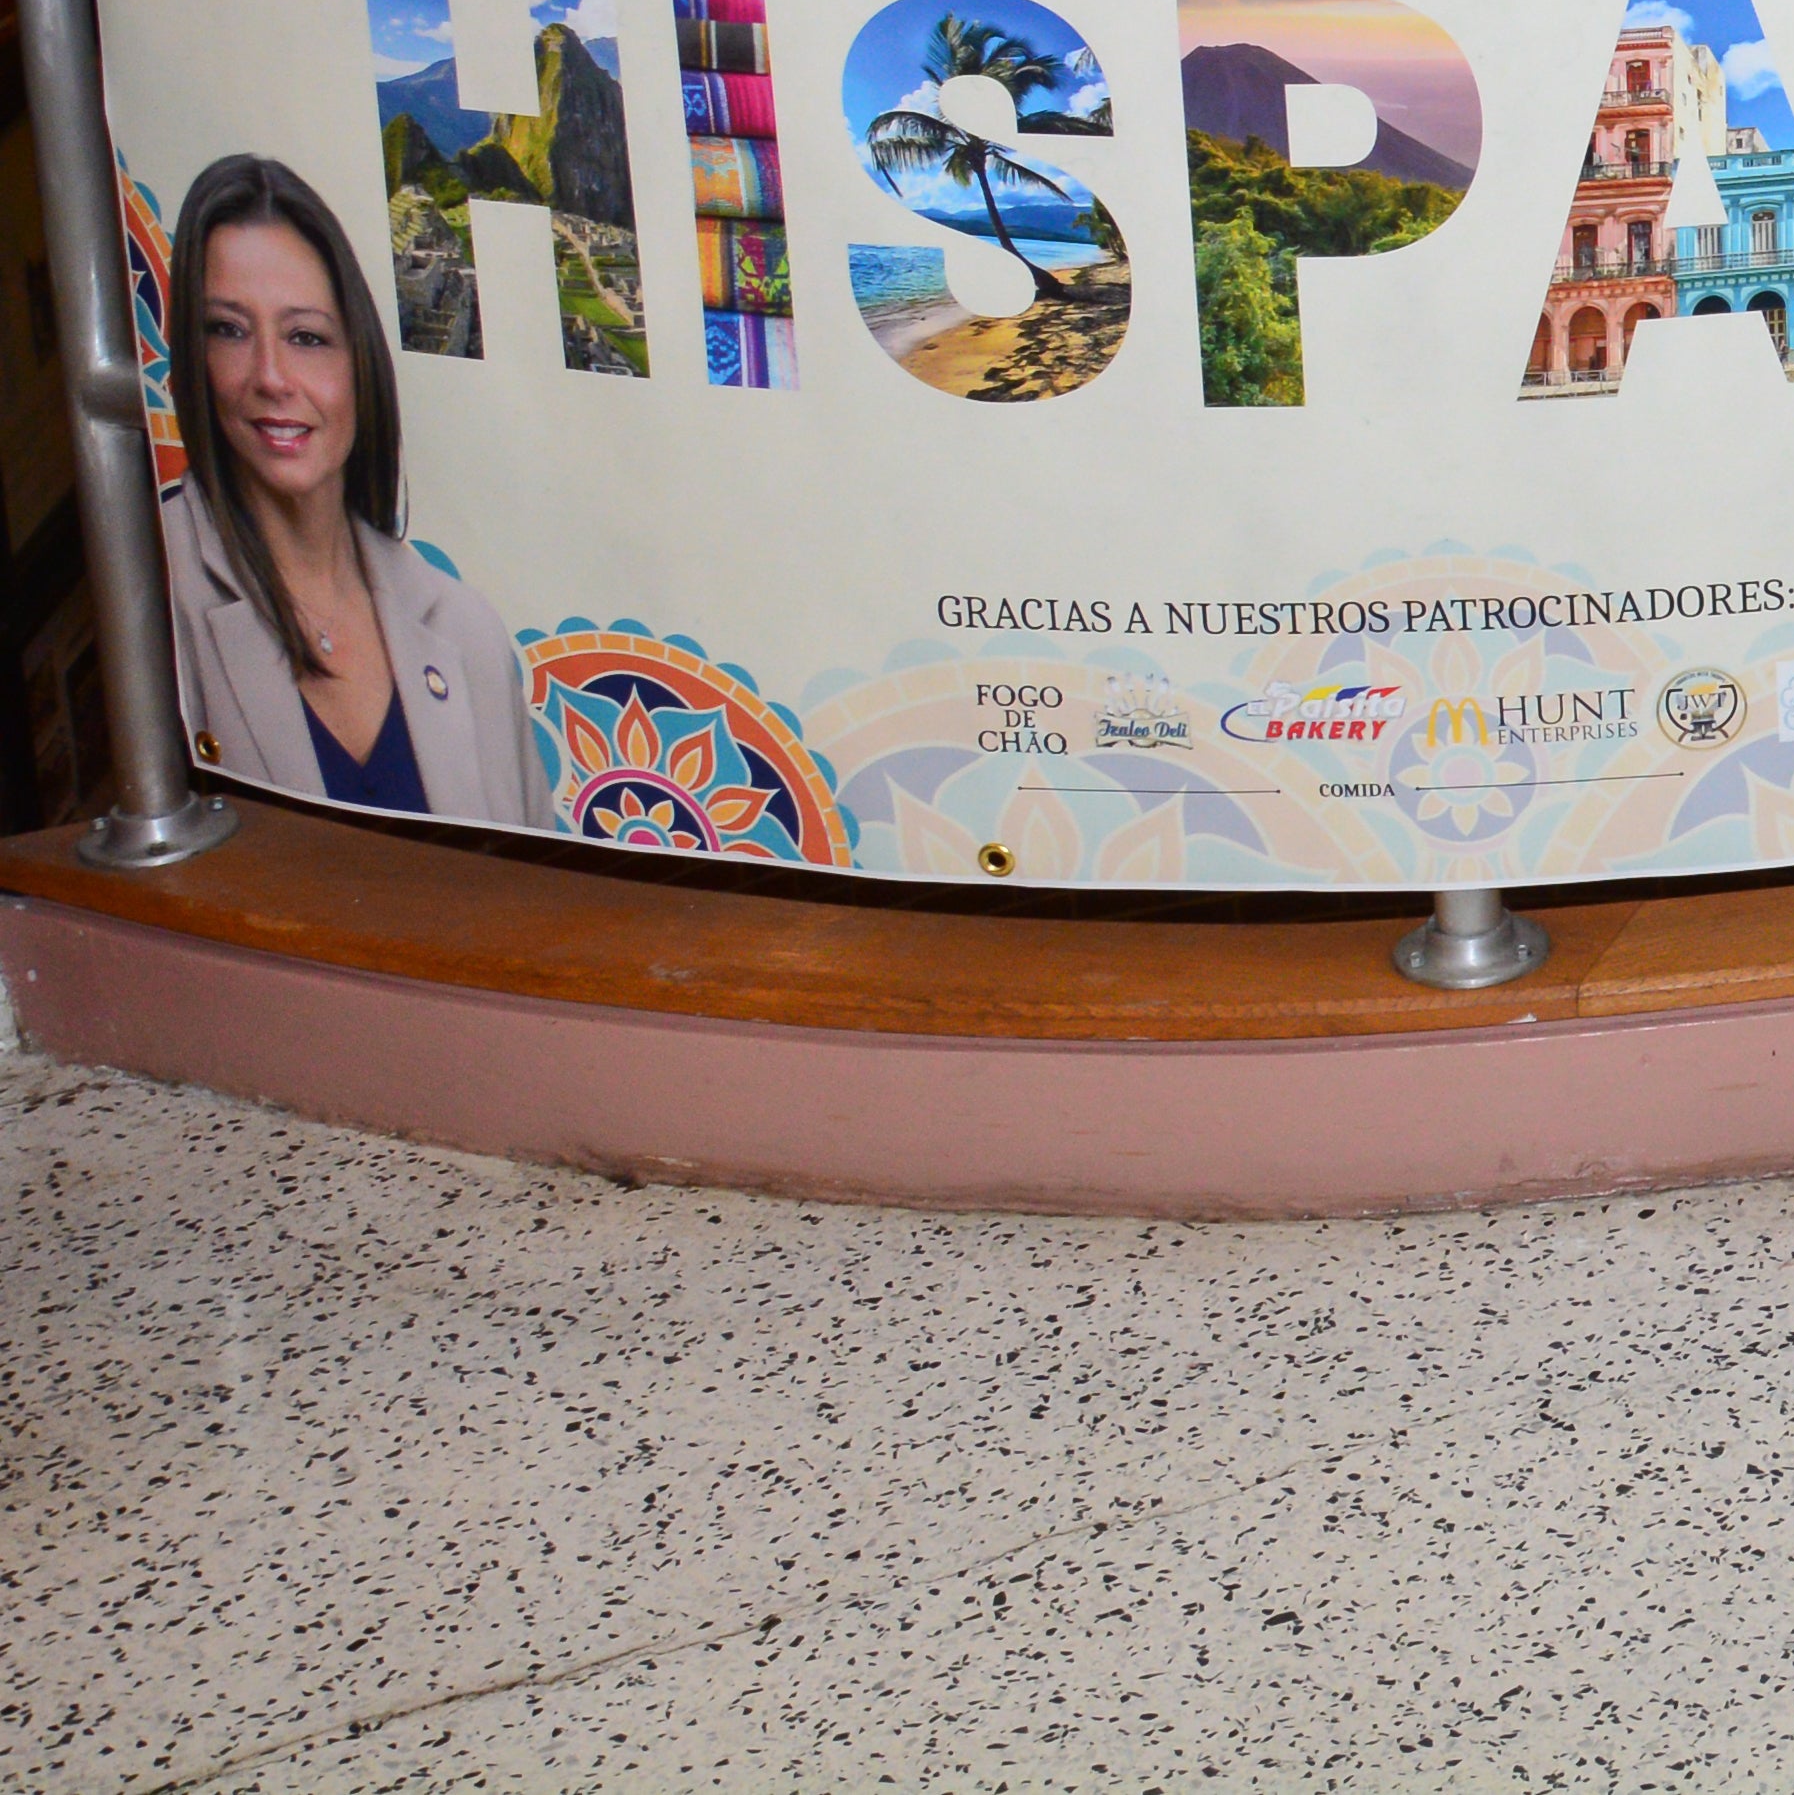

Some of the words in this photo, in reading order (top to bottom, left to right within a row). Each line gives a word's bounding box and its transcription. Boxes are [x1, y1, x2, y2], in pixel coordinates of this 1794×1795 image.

[936, 594, 1113, 634] GRACIAS
[1123, 601, 1155, 635] A
[1163, 599, 1391, 637] NUESTROS
[975, 683, 1064, 709] FOGO
[1496, 688, 1636, 727] HUNT
[1004, 708, 1037, 729] DE
[1153, 720, 1188, 739] Deli
[1265, 719, 1388, 741] BAKERY
[1497, 721, 1639, 746] ENTERPRISES
[1318, 782, 1396, 799] COMIDA
